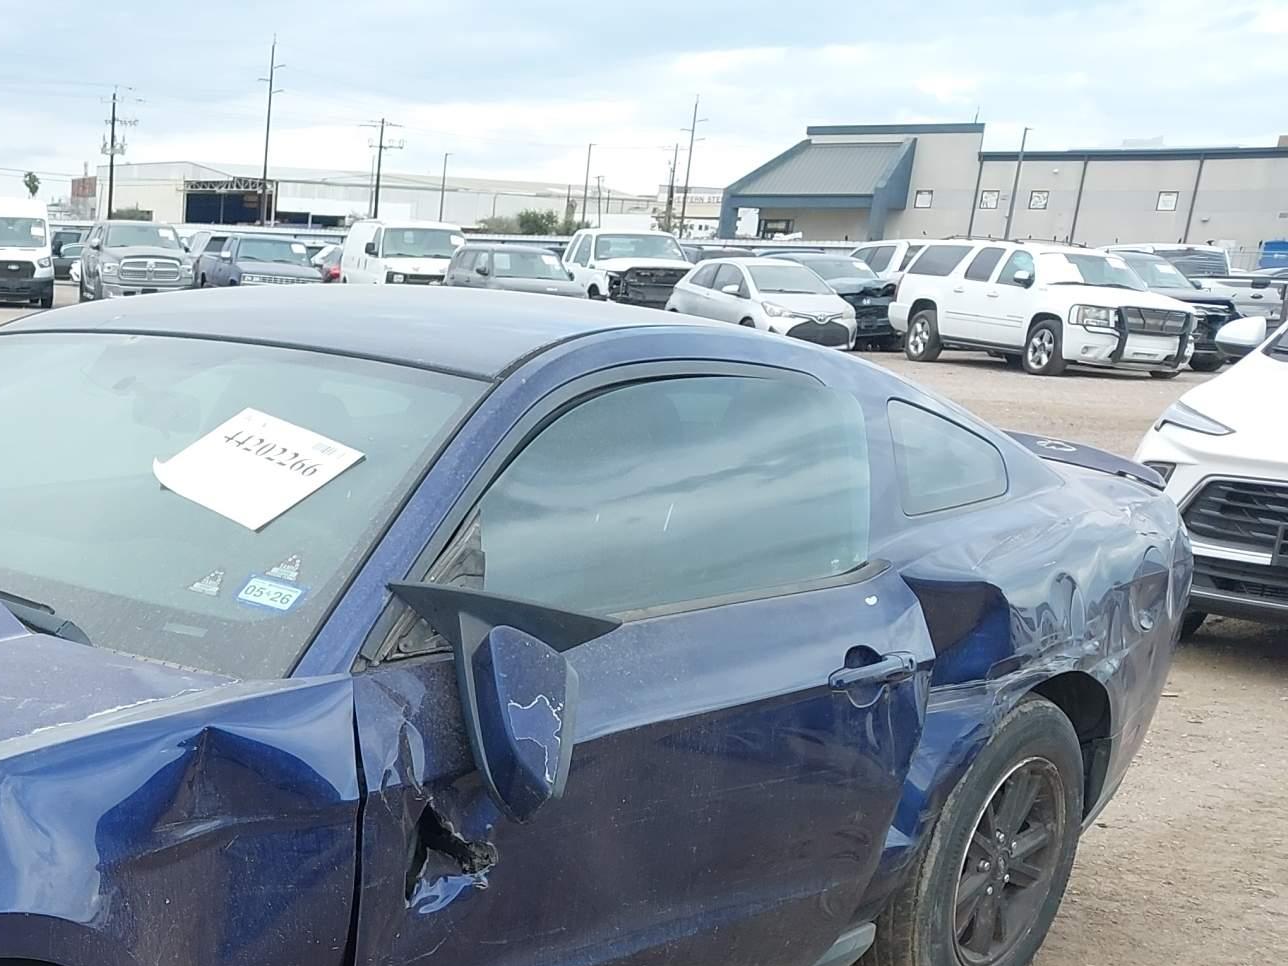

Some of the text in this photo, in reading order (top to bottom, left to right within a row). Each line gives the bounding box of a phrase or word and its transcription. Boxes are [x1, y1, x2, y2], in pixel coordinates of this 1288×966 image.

[224, 431, 320, 476] 44202266
[244, 584, 267, 598] 05
[269, 591, 293, 605] 26
